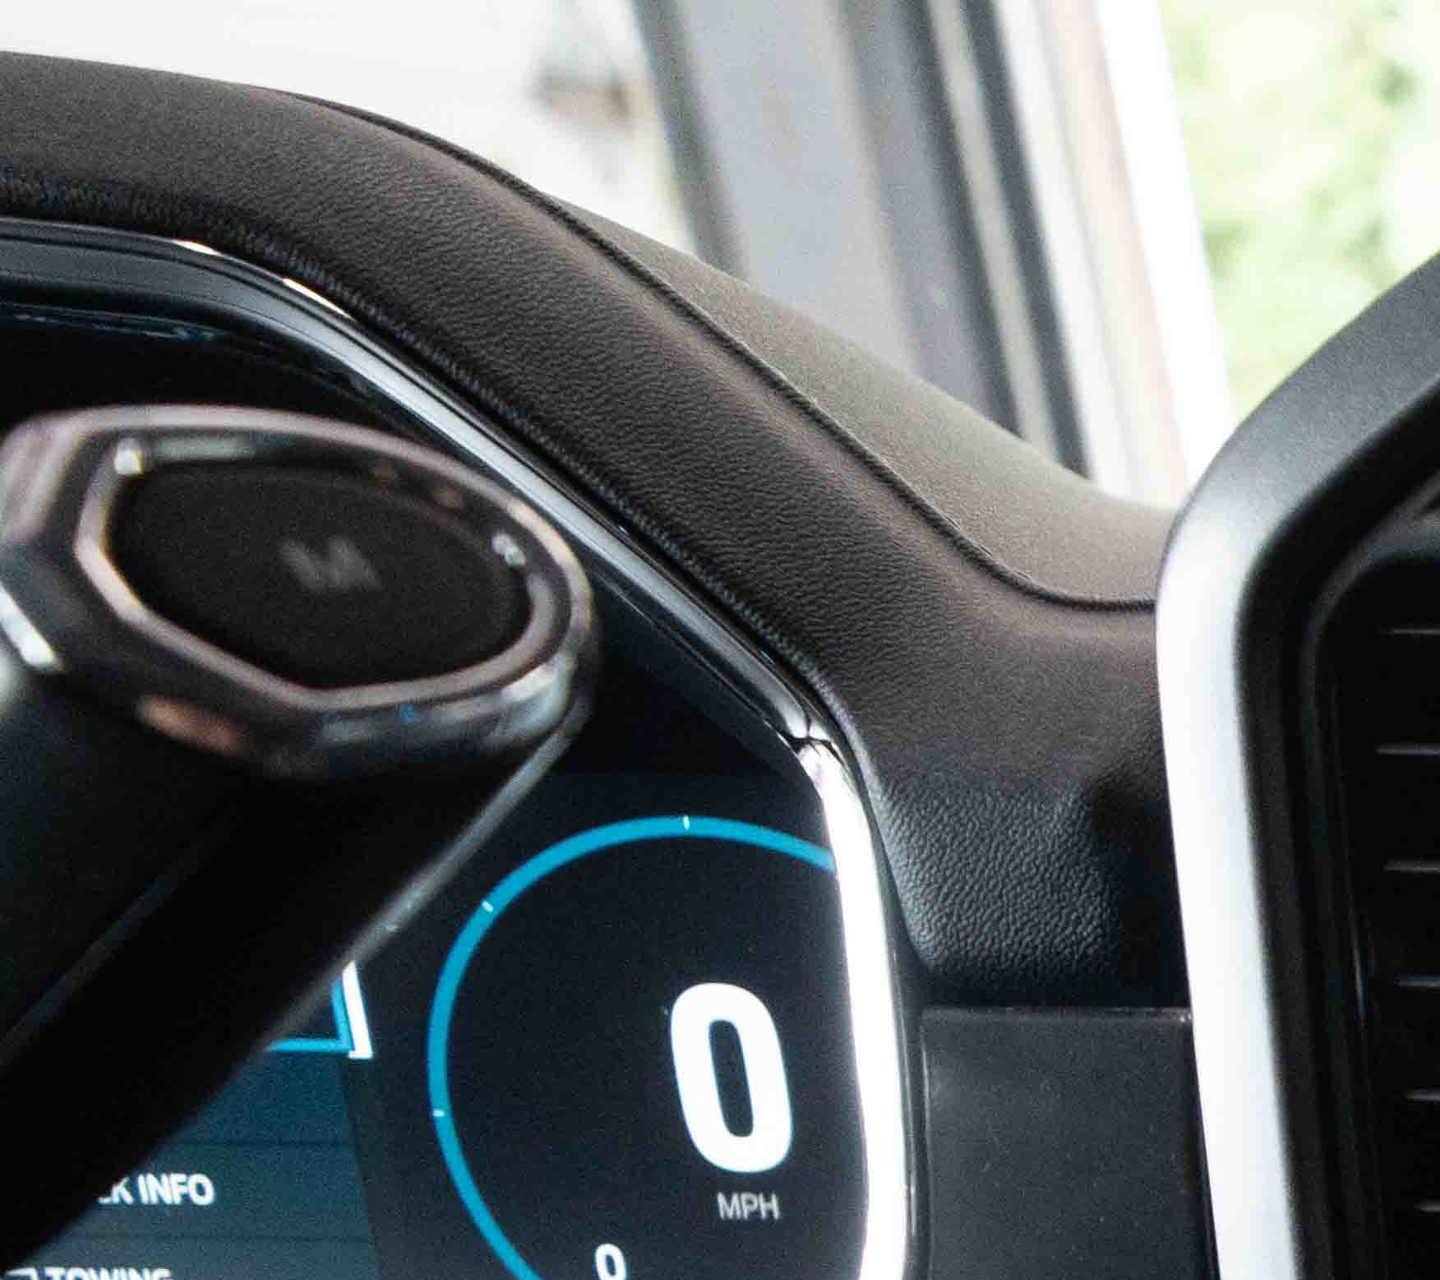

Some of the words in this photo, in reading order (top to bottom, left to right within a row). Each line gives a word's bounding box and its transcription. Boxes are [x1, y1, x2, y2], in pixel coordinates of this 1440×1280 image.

[669, 982, 793, 1174] 0
[137, 1173, 215, 1206] INFO
[717, 1191, 780, 1220] MPH
